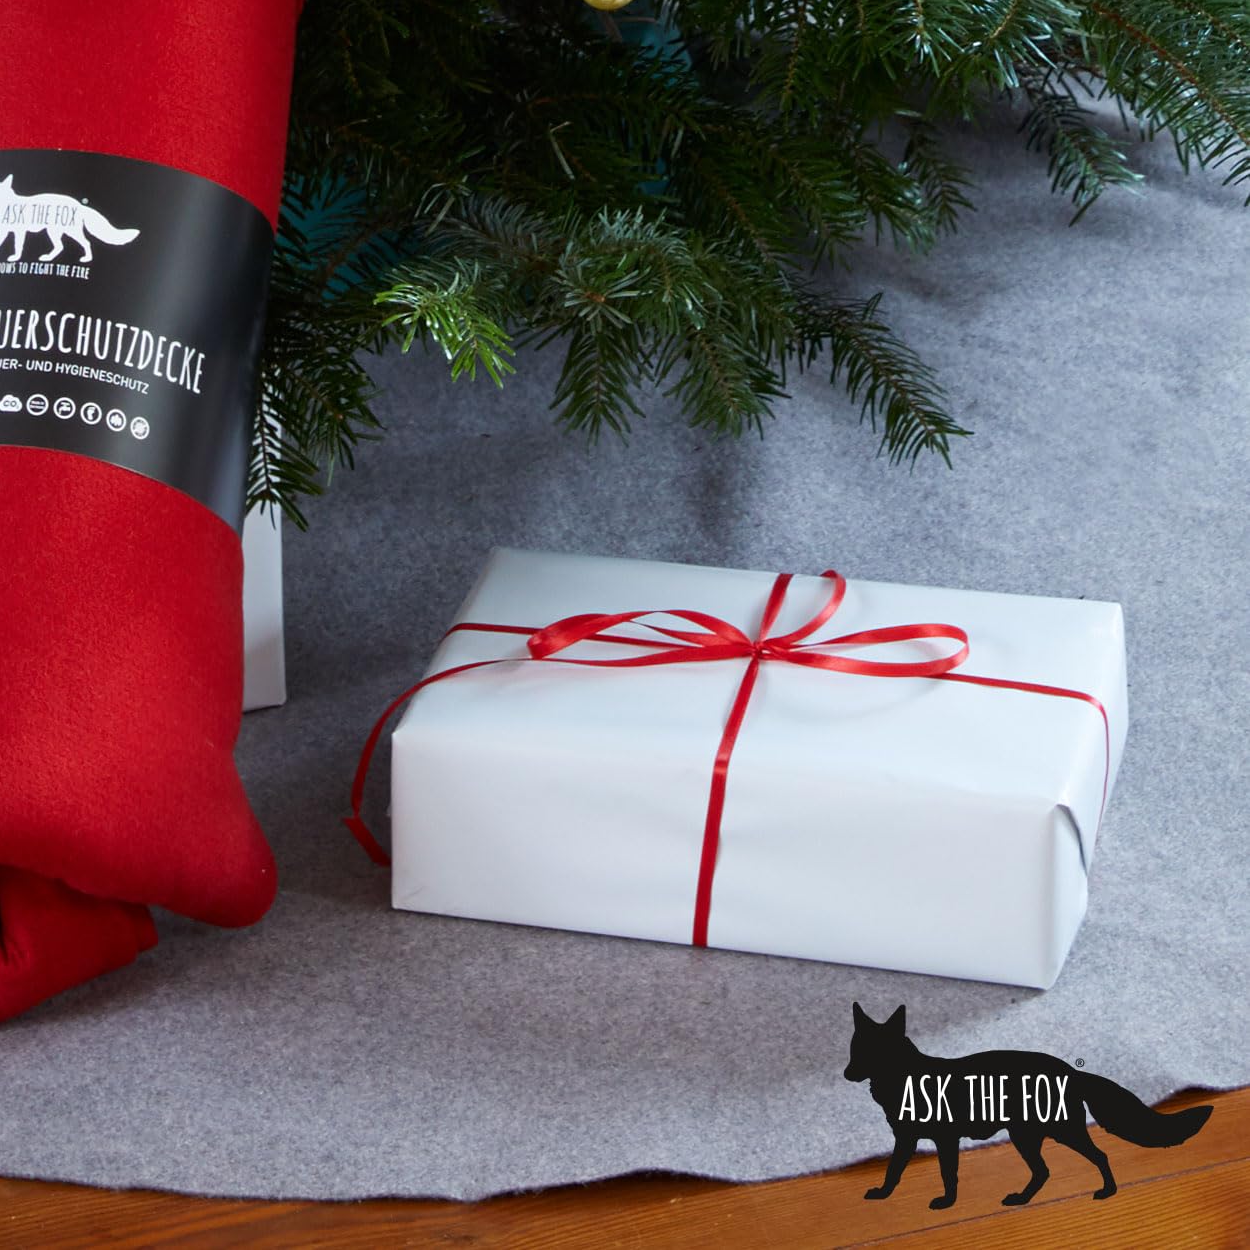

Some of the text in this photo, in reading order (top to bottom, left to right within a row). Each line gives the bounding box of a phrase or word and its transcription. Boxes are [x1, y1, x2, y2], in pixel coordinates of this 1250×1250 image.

[1, 204, 78, 227] ASK THE FOX
[18, 262, 28, 274] TO
[29, 262, 54, 275] FIGHT
[56, 264, 69, 277] THE
[70, 265, 90, 280] FIRE
[26, 359, 52, 373] UND
[56, 362, 150, 395] HYGIENESCHUTZ
